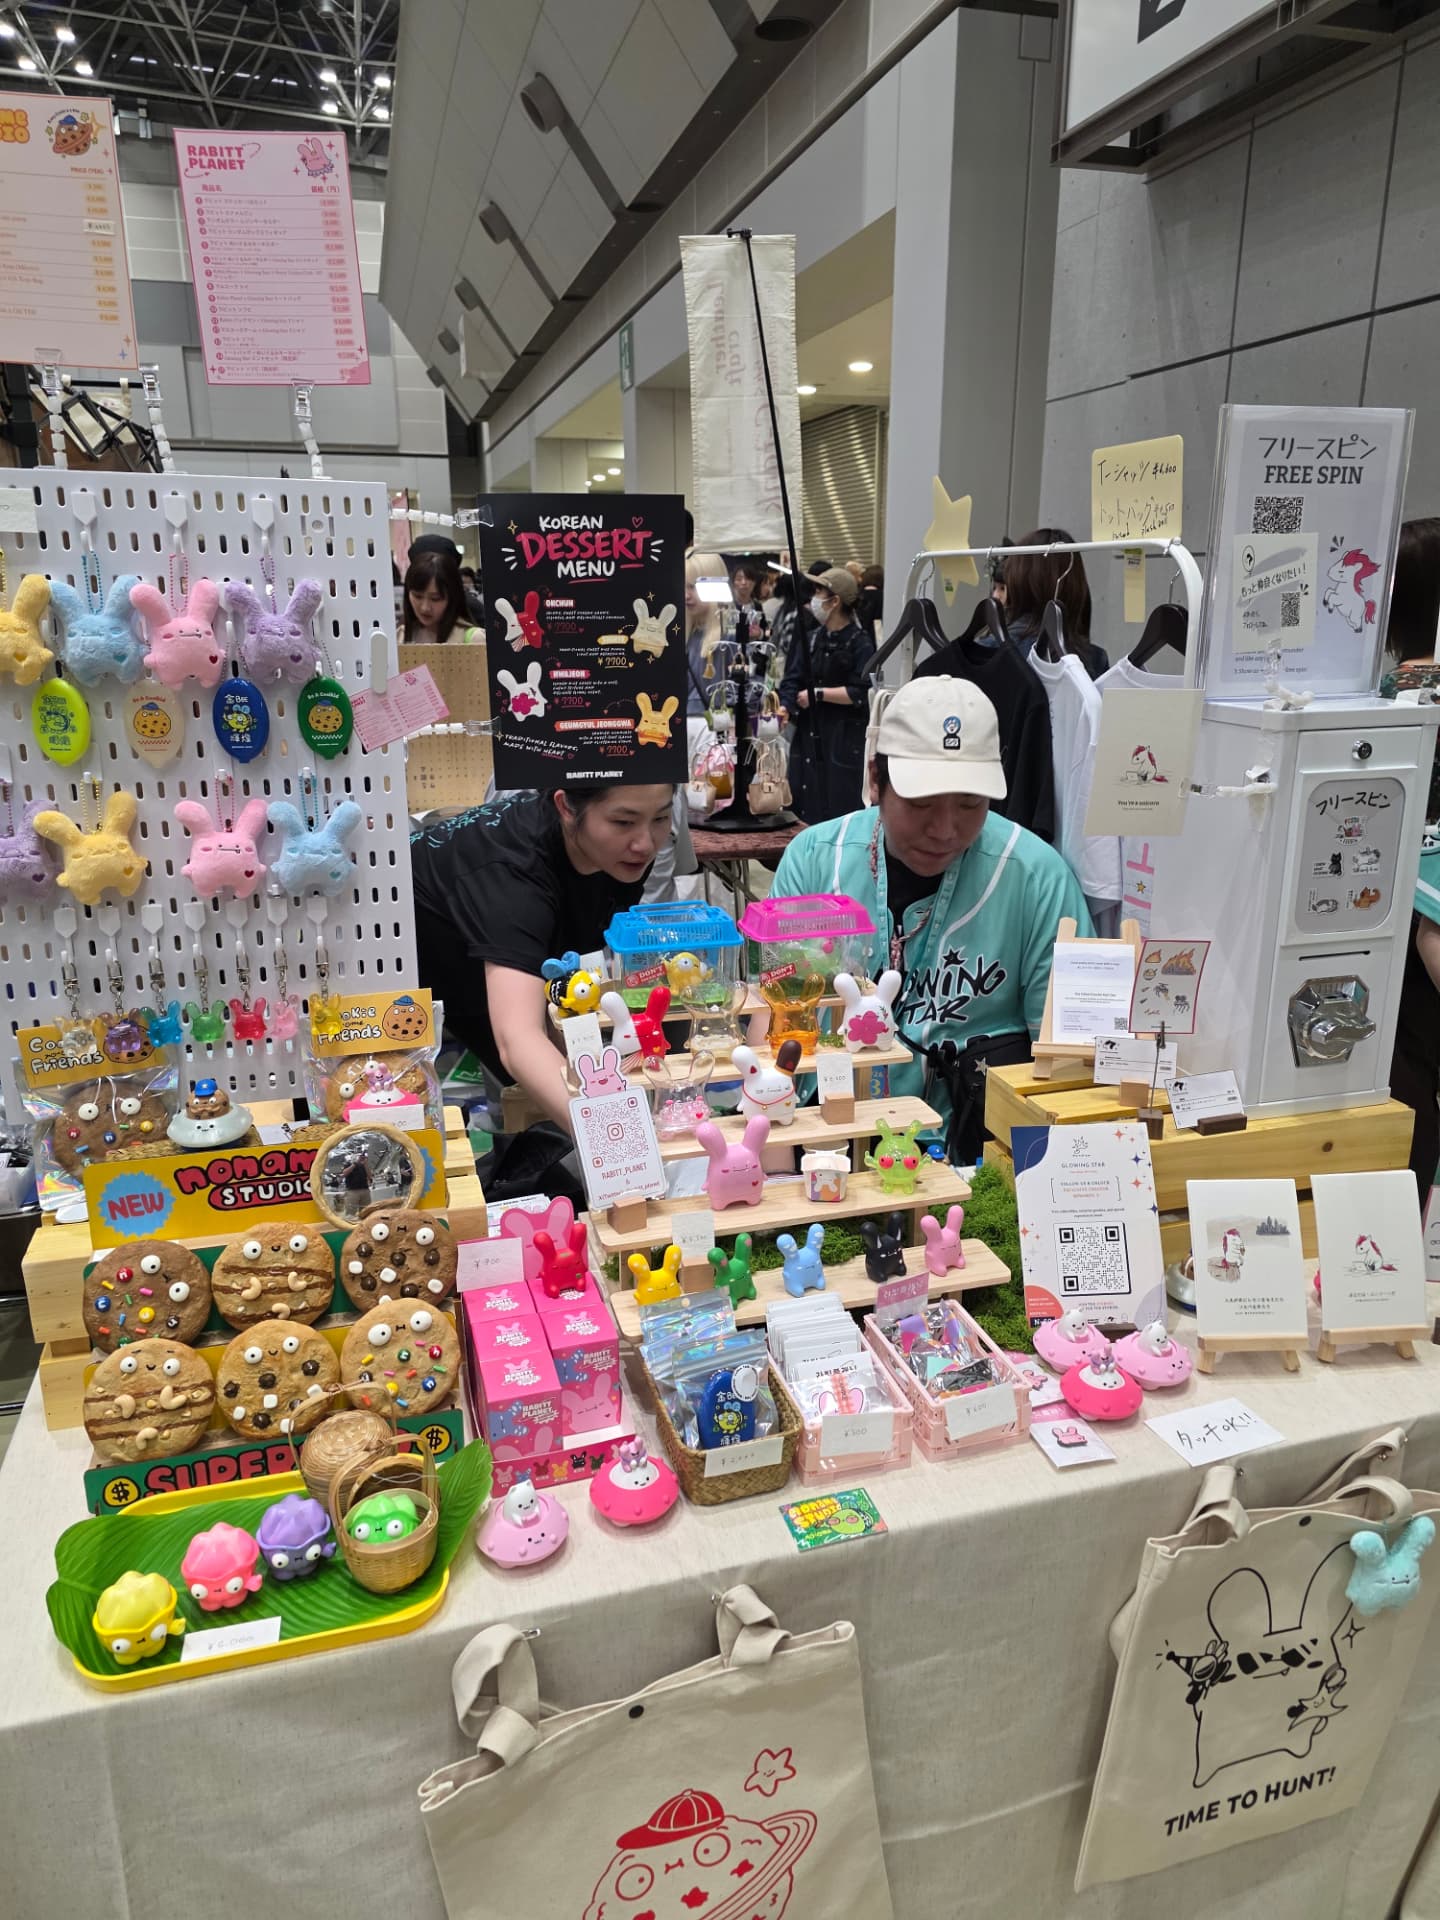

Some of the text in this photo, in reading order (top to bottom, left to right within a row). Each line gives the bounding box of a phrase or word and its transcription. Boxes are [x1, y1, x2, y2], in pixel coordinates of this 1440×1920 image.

[187, 145, 244, 157] RABITT
[188, 157, 246, 170] PLANET
[1258, 434, 1377, 460] フリースピン
[1263, 465, 1364, 485] FREE SPIN
[539, 515, 603, 532] KOREAN
[515, 529, 653, 569] DESSERT
[557, 560, 615, 579] MENU
[639, 966, 663, 977] DON'T
[770, 964, 795, 977] DON'T
[902, 995, 971, 1026] TAR
[173, 1148, 318, 1195] nonam
[601, 1162, 647, 1181] RABITT_PLANET
[107, 1191, 164, 1221] NEW
[1164, 1766, 1337, 1836] TIME TO HUNT!
